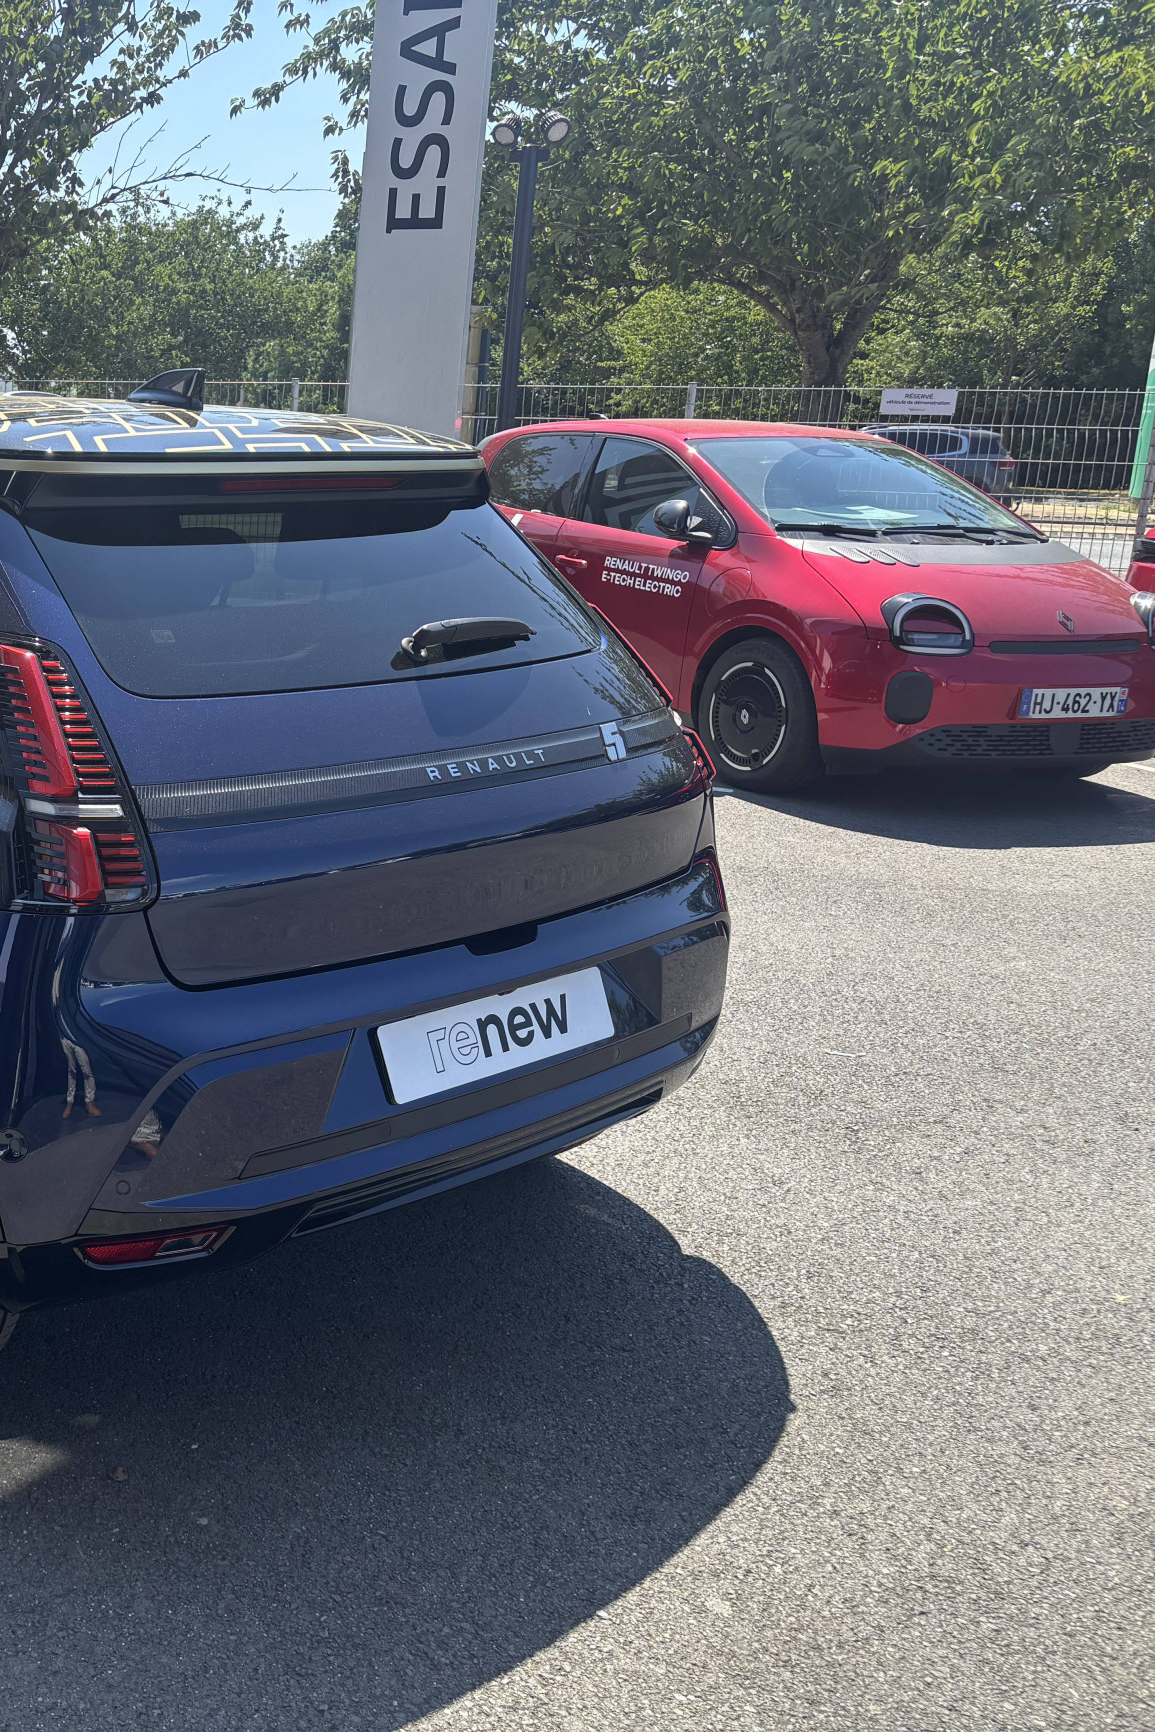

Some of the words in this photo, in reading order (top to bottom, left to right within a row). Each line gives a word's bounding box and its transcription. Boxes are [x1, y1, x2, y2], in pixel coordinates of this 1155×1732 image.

[604, 556, 647, 574] RENAULT
[648, 564, 689, 583] TWINGO
[601, 571, 634, 587] E-TECH
[635, 578, 682, 597] ELECTRIC
[1031, 691, 1118, 715] HJ-462-YX
[426, 750, 547, 781] RENAULT
[599, 722, 627, 761] 5
[426, 993, 569, 1074] renew
